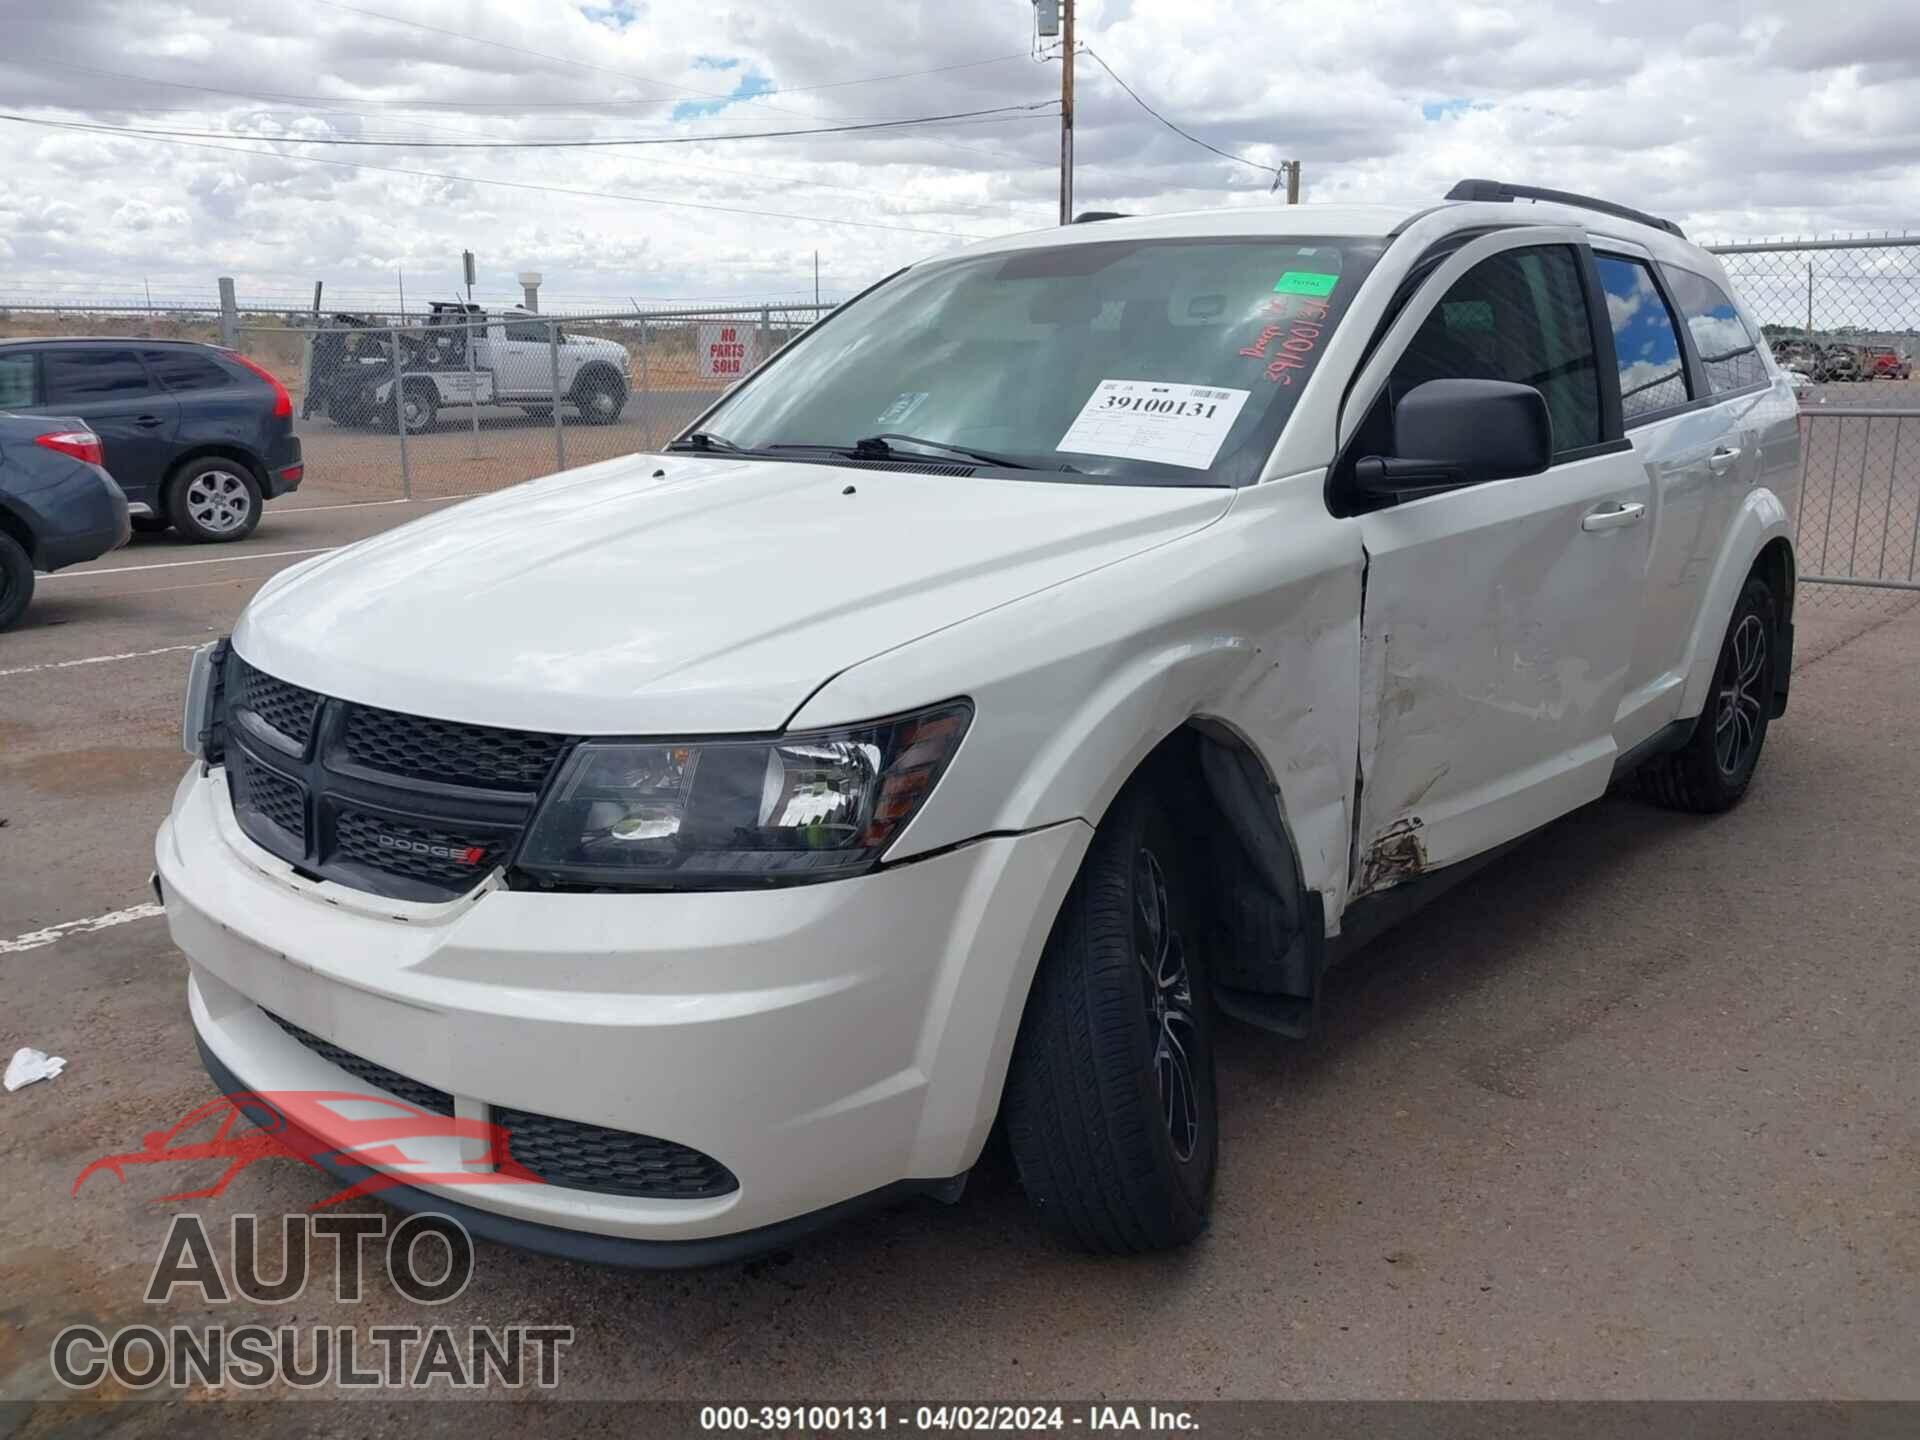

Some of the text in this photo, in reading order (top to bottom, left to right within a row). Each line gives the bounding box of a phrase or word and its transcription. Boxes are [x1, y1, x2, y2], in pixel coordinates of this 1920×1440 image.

[721, 328, 737, 342] NO
[1264, 299, 1330, 385] 39100131
[710, 343, 745, 358] PARTS
[712, 360, 740, 373] SOLD
[1099, 395, 1218, 419] 39100131
[379, 834, 468, 861] DODGE
